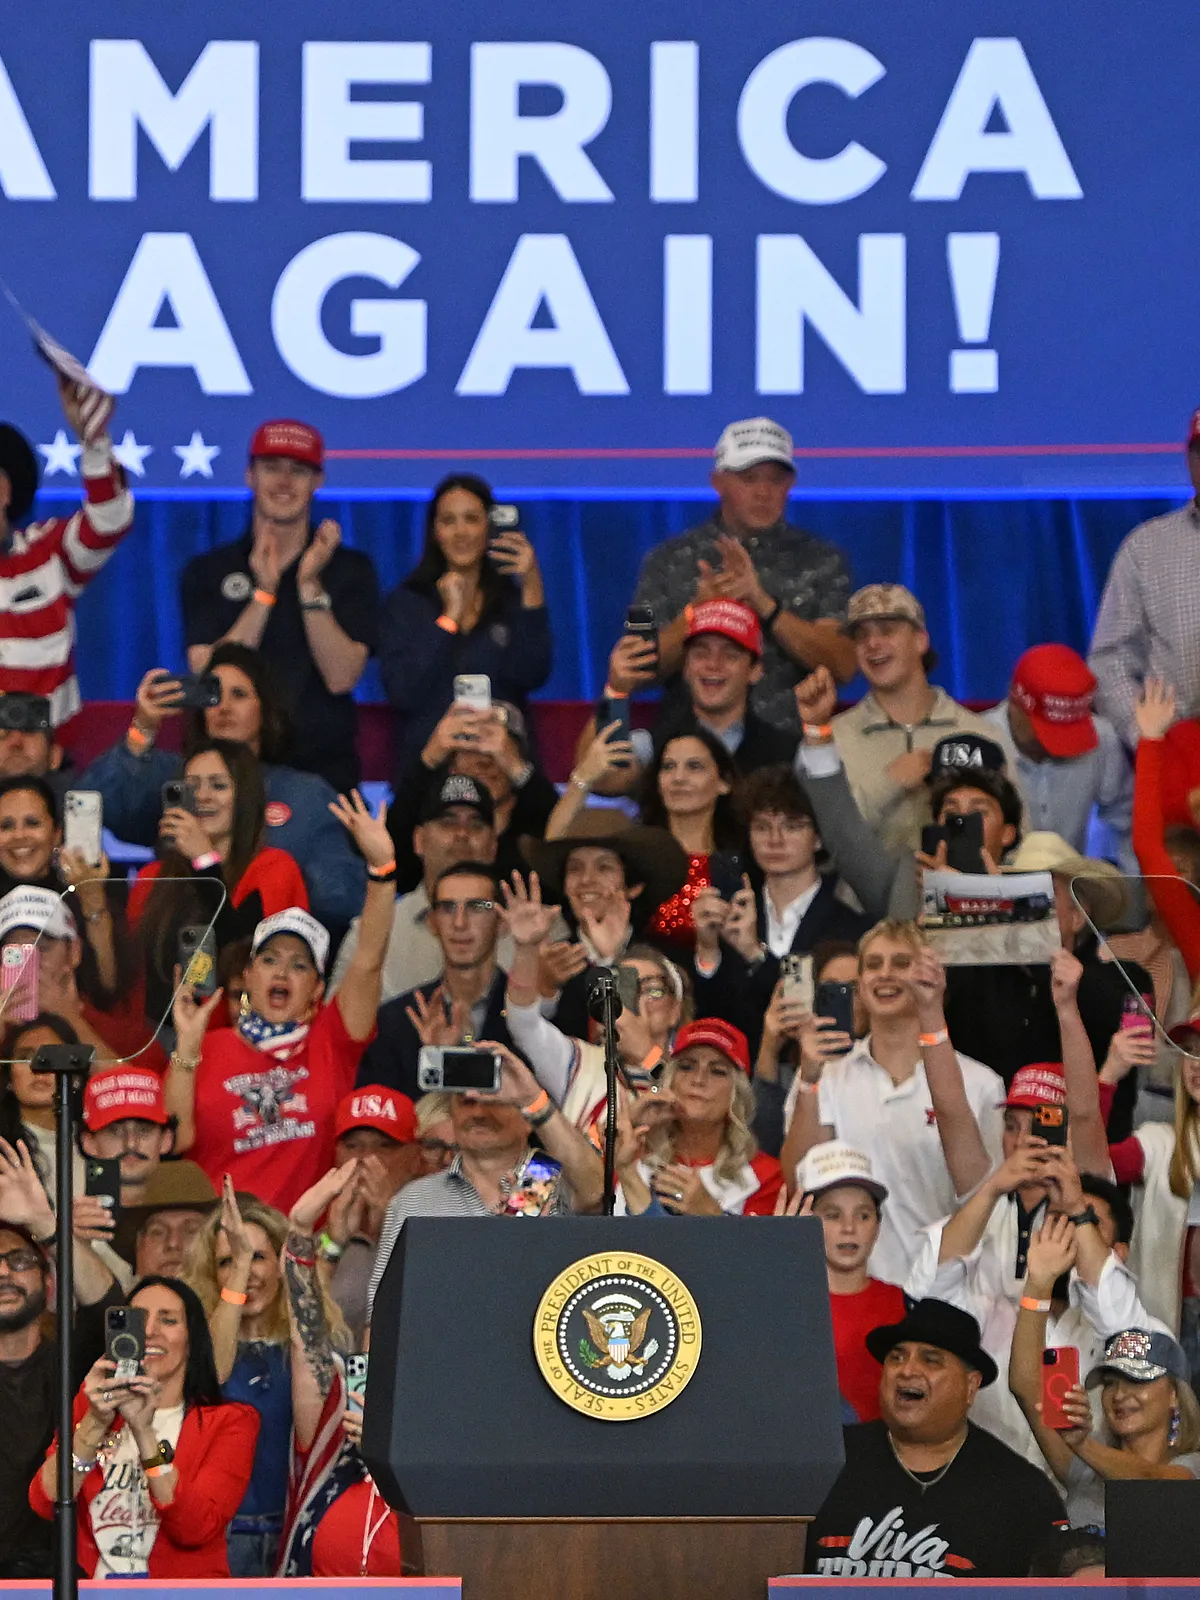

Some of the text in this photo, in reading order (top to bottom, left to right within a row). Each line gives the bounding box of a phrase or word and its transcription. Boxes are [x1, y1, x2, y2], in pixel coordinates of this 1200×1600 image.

[86, 232, 999, 397] AGAIN!
[940, 743, 983, 767] USA
[351, 1094, 397, 1121] USA
[541, 1258, 696, 1412] SEAL OF THE PRESIDENT OF THE UNITED STATES
[847, 1505, 950, 1571] Viva
[816, 1556, 956, 1579] TRUM
